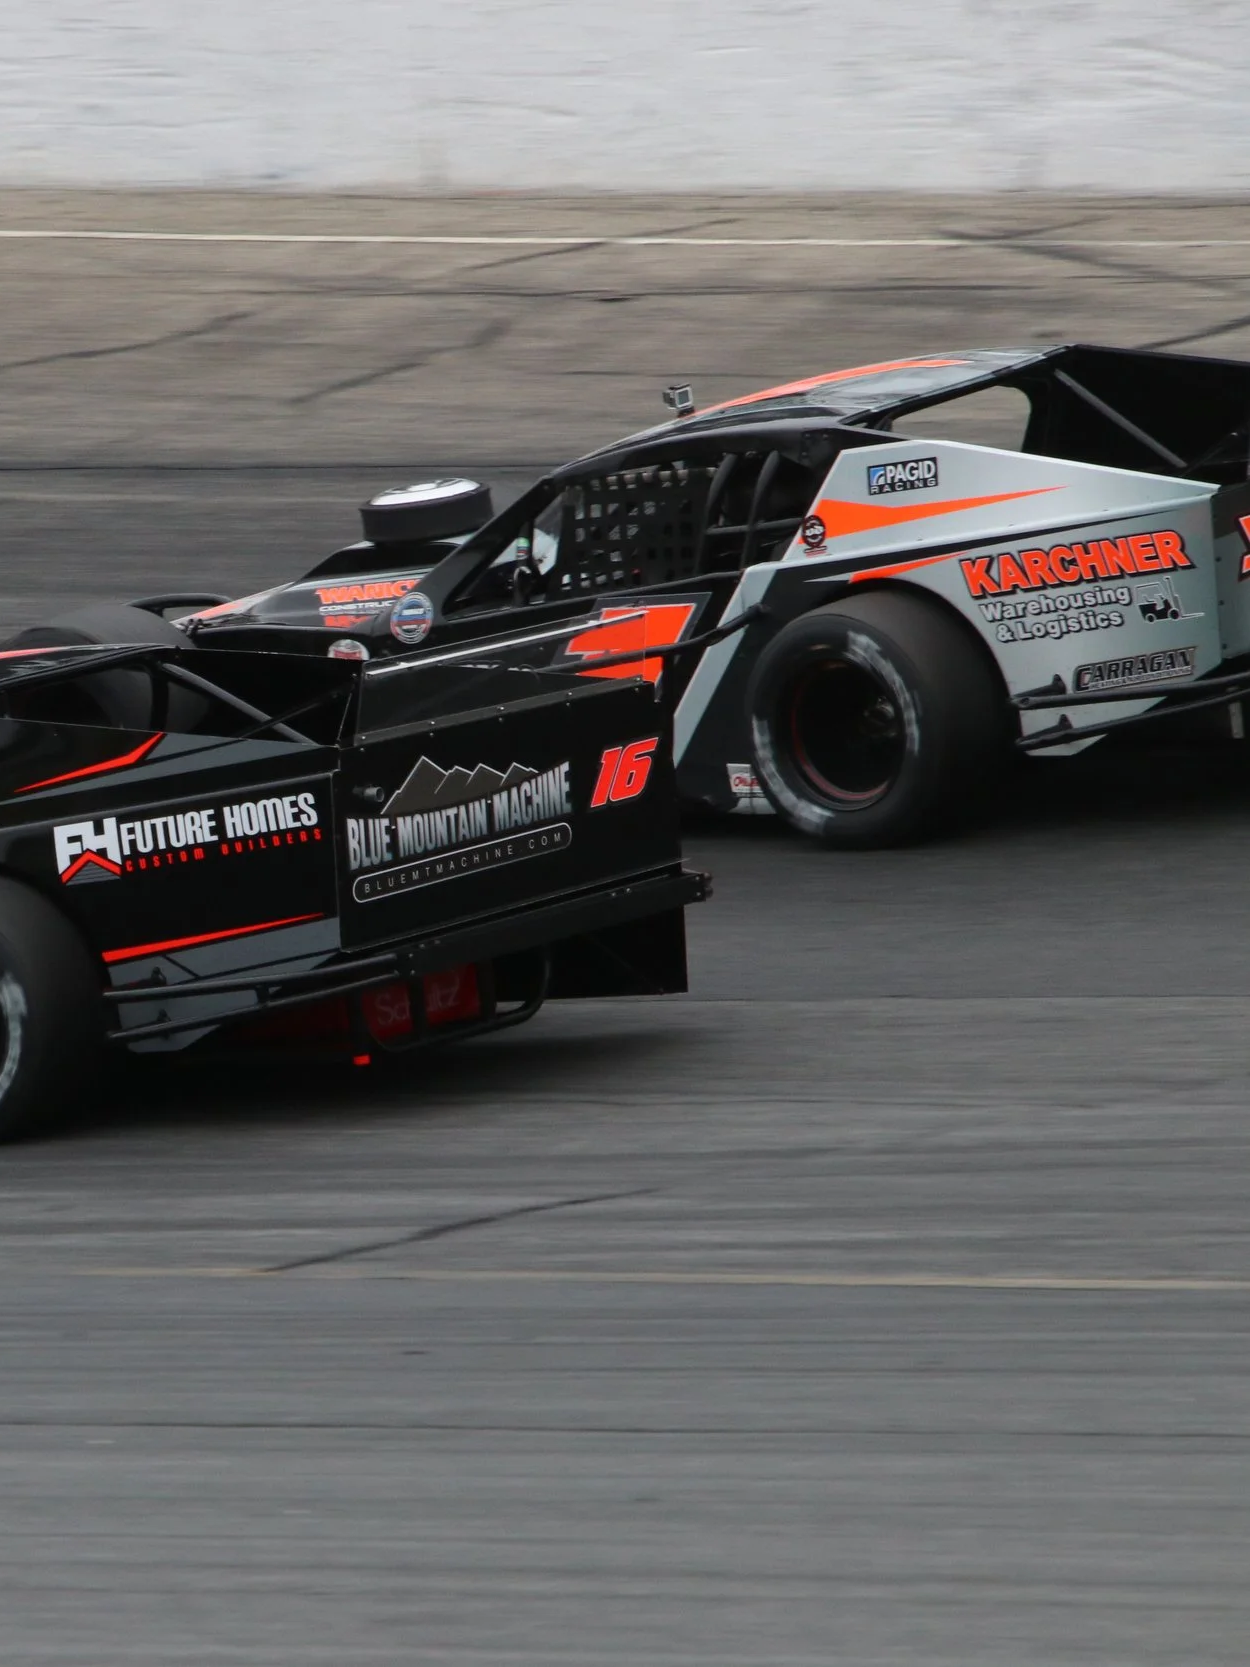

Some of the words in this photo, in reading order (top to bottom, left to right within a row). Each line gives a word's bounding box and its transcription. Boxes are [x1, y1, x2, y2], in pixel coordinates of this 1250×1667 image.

[871, 477, 937, 495] RACING
[885, 460, 936, 484] PAGID
[960, 530, 1195, 598] KARCHNER
[315, 579, 422, 604] WANIC
[980, 586, 1132, 623] Warehousing
[996, 622, 1015, 643] &
[1016, 610, 1124, 639] Logistics
[1072, 648, 1196, 692] CARRAGAN
[590, 738, 659, 809] 16
[119, 809, 219, 856] FUTURE
[223, 792, 319, 839] HOMES
[346, 818, 393, 871] BLUE
[396, 798, 490, 858] MOUNTAIN
[492, 761, 572, 832] MACHINE
[125, 847, 206, 873] CUSTOM
[221, 827, 323, 856] BUILDERS
